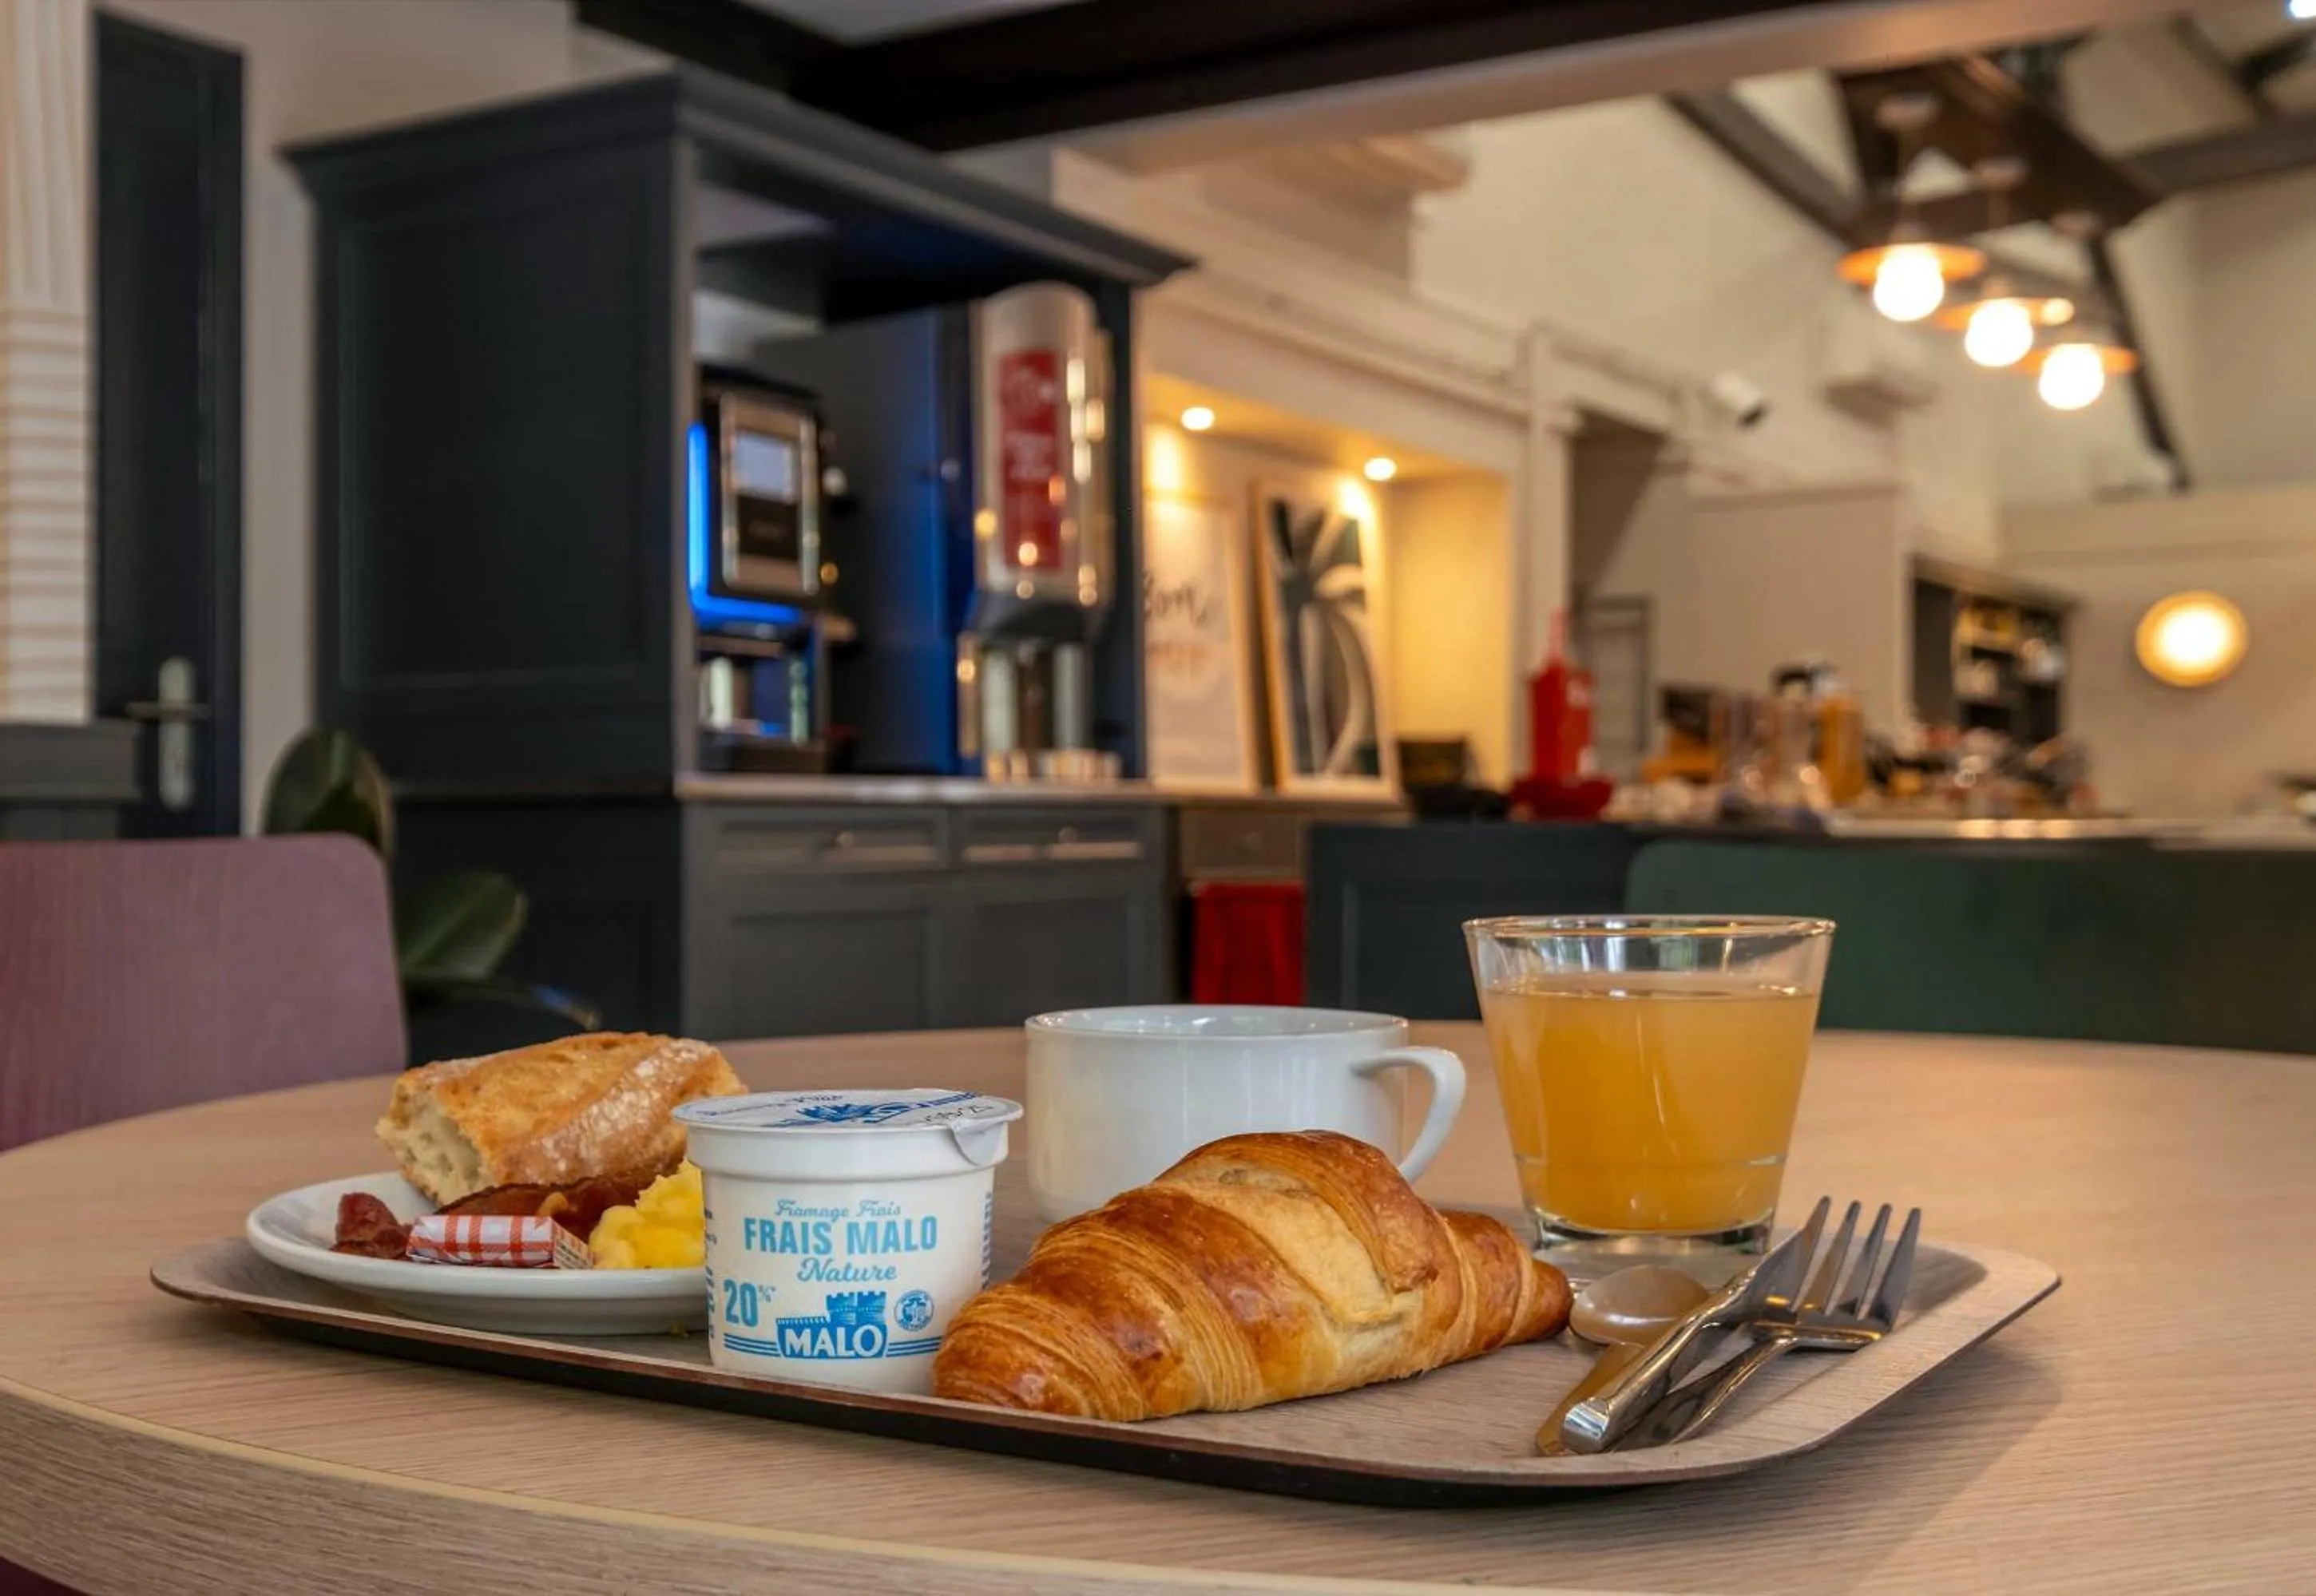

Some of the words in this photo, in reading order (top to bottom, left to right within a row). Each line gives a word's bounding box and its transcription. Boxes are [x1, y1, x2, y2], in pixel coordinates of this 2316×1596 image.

[775, 1198, 848, 1222] Fromage
[856, 1199, 901, 1218] Frais
[744, 1217, 832, 1255] FRAIS
[847, 1215, 938, 1255] MALO
[797, 1257, 897, 1282] Nature
[785, 1325, 882, 1357] MALO
